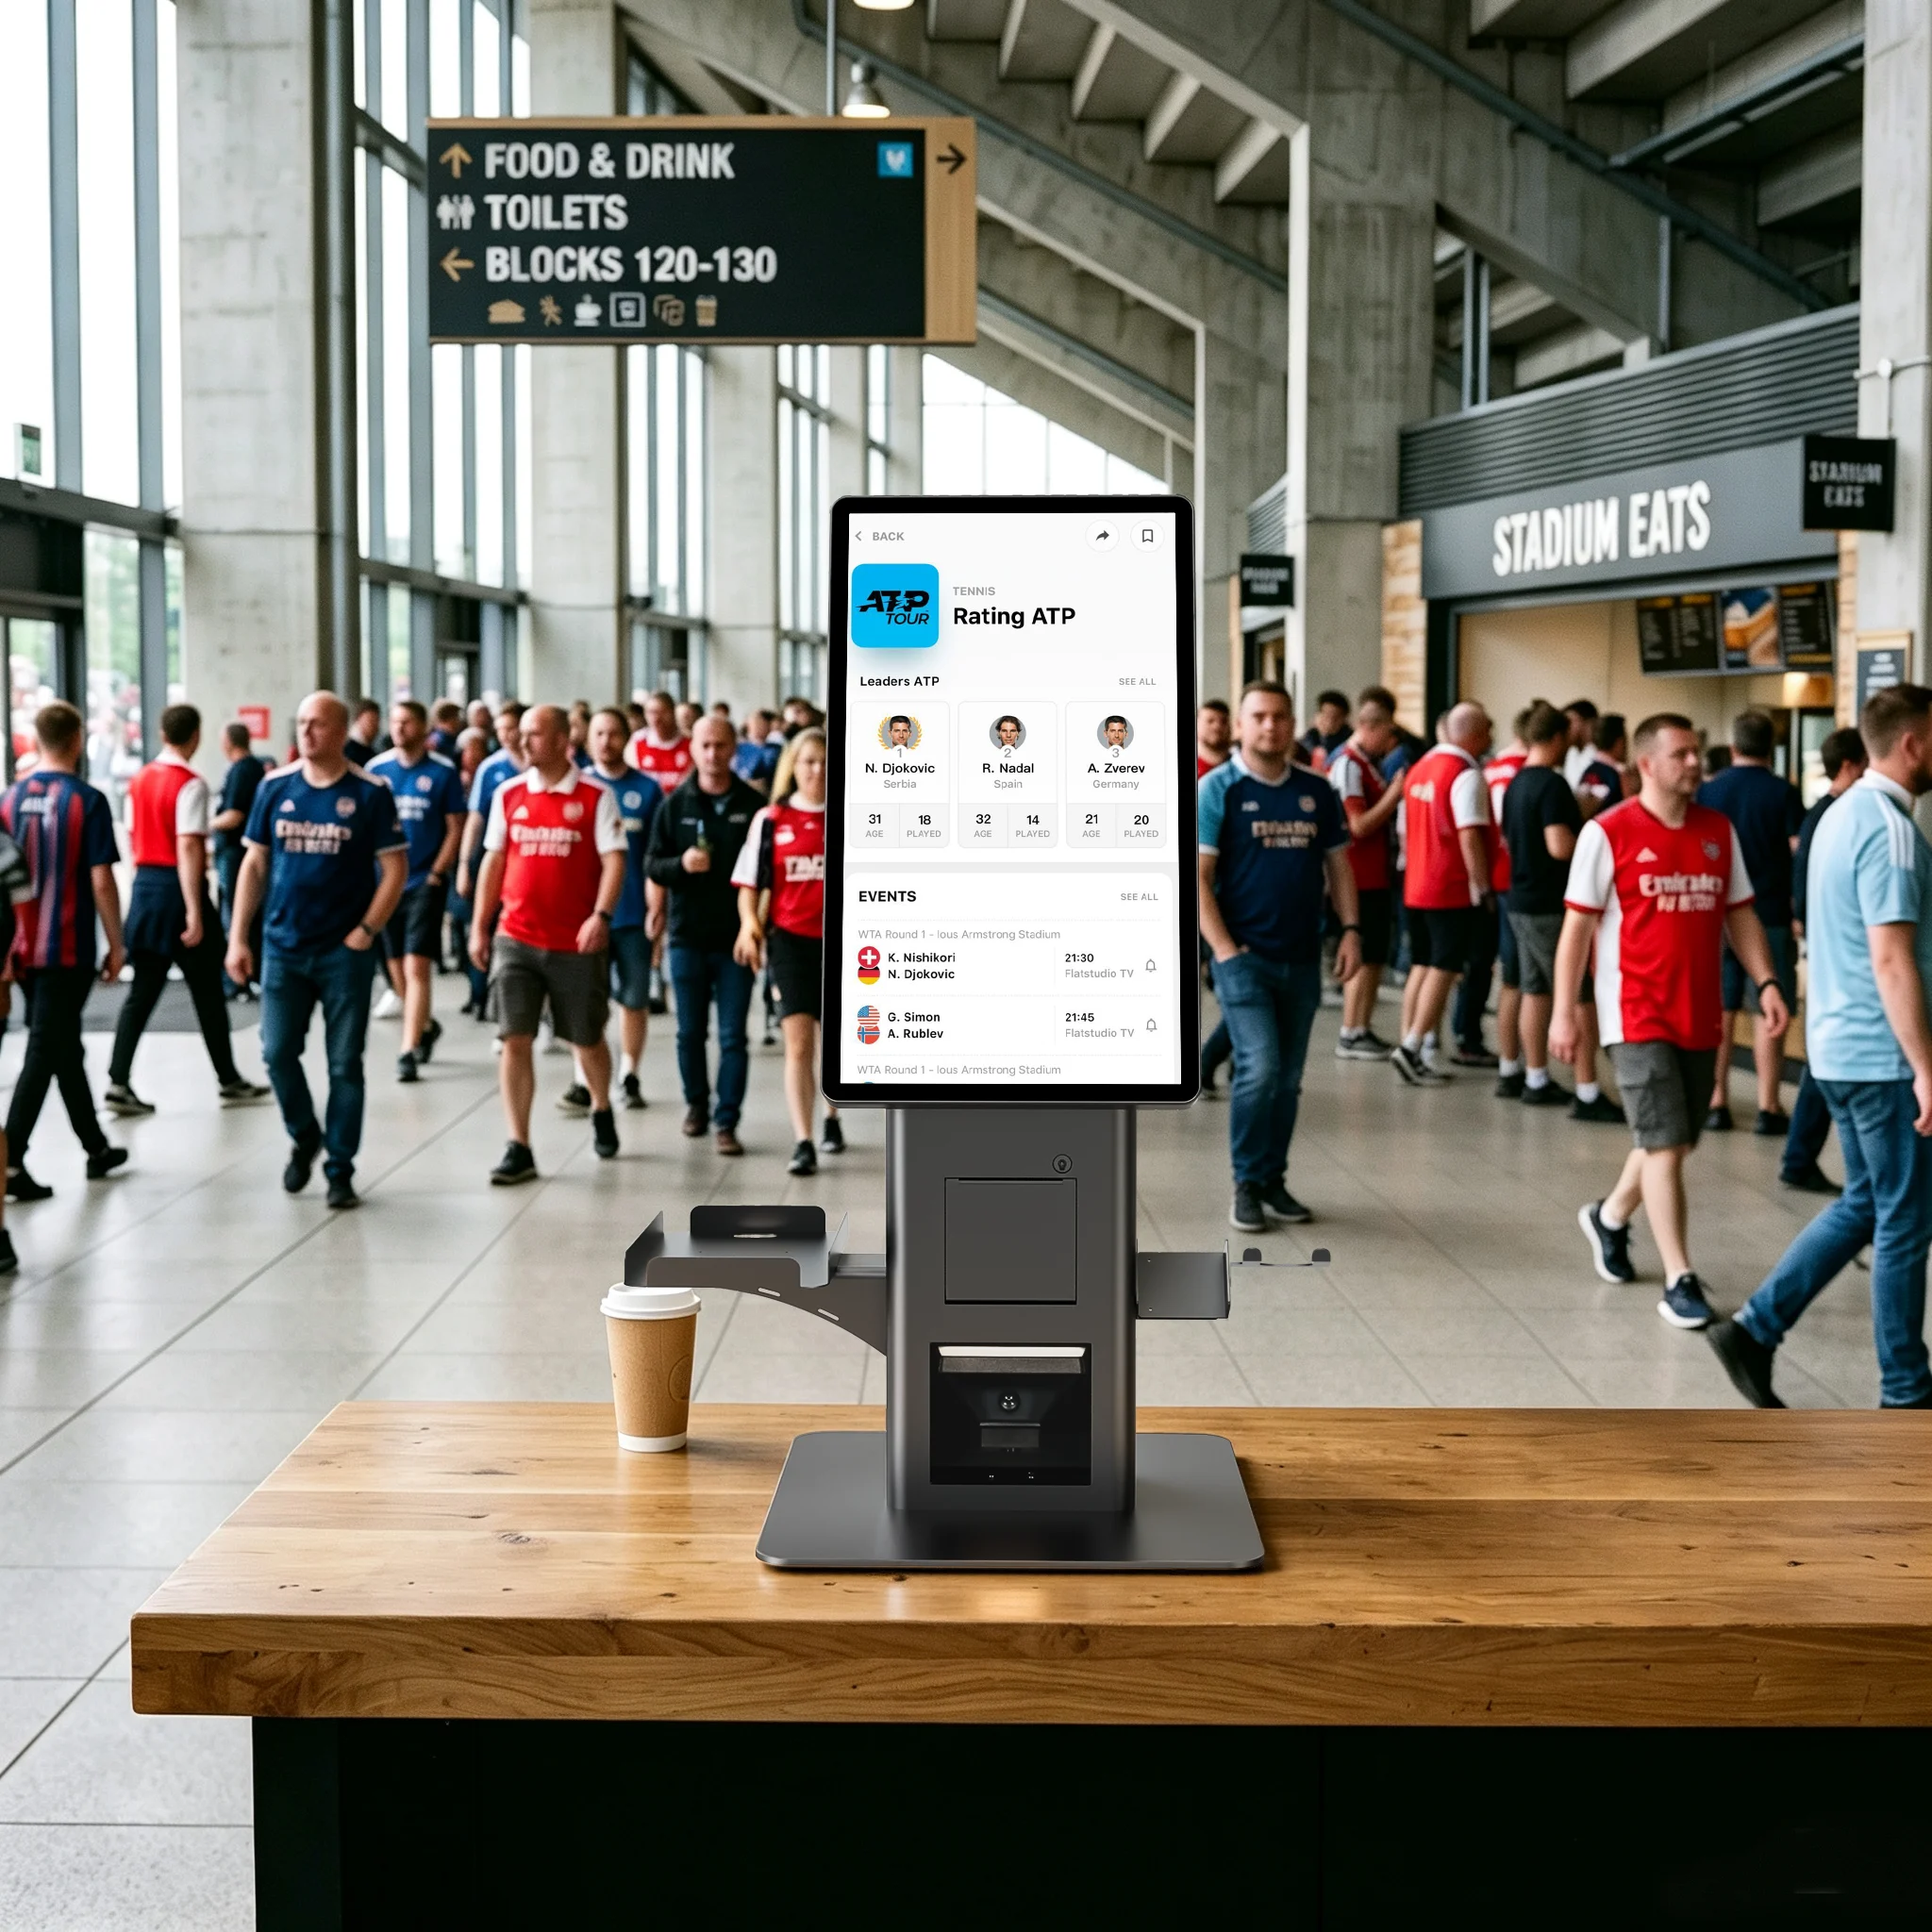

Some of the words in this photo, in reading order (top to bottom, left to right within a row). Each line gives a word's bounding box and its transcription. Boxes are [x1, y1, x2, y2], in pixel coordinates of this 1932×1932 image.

[484, 142, 579, 179] FOOD
[588, 142, 616, 179] &
[625, 142, 735, 179] DRINK
[483, 192, 629, 231] TOILETS
[485, 245, 625, 283] BLOCKS
[634, 245, 778, 283] 120-130
[1492, 495, 1620, 577] STADIUM
[1628, 479, 1711, 559] EATS
[872, 531, 906, 541] BACK
[952, 586, 996, 596] TENNIS
[858, 590, 930, 612] ATP
[885, 612, 930, 625] TOUR
[953, 606, 1025, 630] Rating
[1031, 607, 1076, 625] ATP
[859, 675, 911, 687] Leaders
[913, 675, 941, 687] ATP
[1118, 677, 1137, 686] SEE
[1138, 677, 1158, 686] ALL
[896, 748, 903, 758] 1
[1003, 748, 1012, 758] 2
[1111, 748, 1121, 758] 3
[864, 762, 878, 774] N.
[882, 762, 936, 776] Djokovic
[982, 762, 995, 774] R.
[999, 762, 1035, 774] Nadal
[1087, 762, 1100, 774] A.
[1103, 762, 1146, 774] Zverev
[883, 778, 917, 789] Serbia
[993, 778, 1024, 791] Spain
[1092, 779, 1141, 791] Germany
[868, 813, 882, 824] 31
[917, 814, 932, 826] 18
[974, 813, 992, 824] 32
[1025, 814, 1041, 825] 14
[1085, 813, 1099, 824] 21
[1133, 814, 1150, 825] 20
[864, 829, 884, 838] AGE
[906, 829, 942, 838] PLAYED
[973, 829, 992, 839] AGE
[1015, 829, 1051, 838] PLAYED
[1081, 829, 1101, 839] AGE
[1124, 829, 1159, 838] PLAYED
[858, 890, 917, 903] EVENTS
[1120, 892, 1139, 901] SEE
[1141, 892, 1159, 901] ALL
[858, 929, 883, 940] WTA
[885, 929, 919, 940] Round
[921, 929, 926, 940] 1
[960, 929, 1016, 941] Armstrong
[1018, 929, 1061, 940] Stadium
[888, 952, 900, 963] K.
[903, 952, 956, 963] Nishikori
[1064, 953, 1095, 963] 21:30
[888, 969, 901, 979] N.
[904, 968, 956, 982] Djokovic
[1064, 968, 1117, 978] Flatstudio
[1119, 969, 1135, 978] TV
[887, 1011, 901, 1023] G.
[904, 1011, 941, 1023] Simon
[1065, 1012, 1095, 1023] 21:45
[887, 1028, 900, 1040] A.
[903, 1027, 944, 1040] Rublev
[1064, 1027, 1118, 1039] Flatstudio
[1120, 1027, 1135, 1038] TV
[857, 1064, 882, 1074] WTA
[884, 1064, 918, 1074] Round
[920, 1065, 925, 1074] 1
[960, 1065, 1016, 1077] Armstrong
[1018, 1064, 1061, 1075] Stadium
